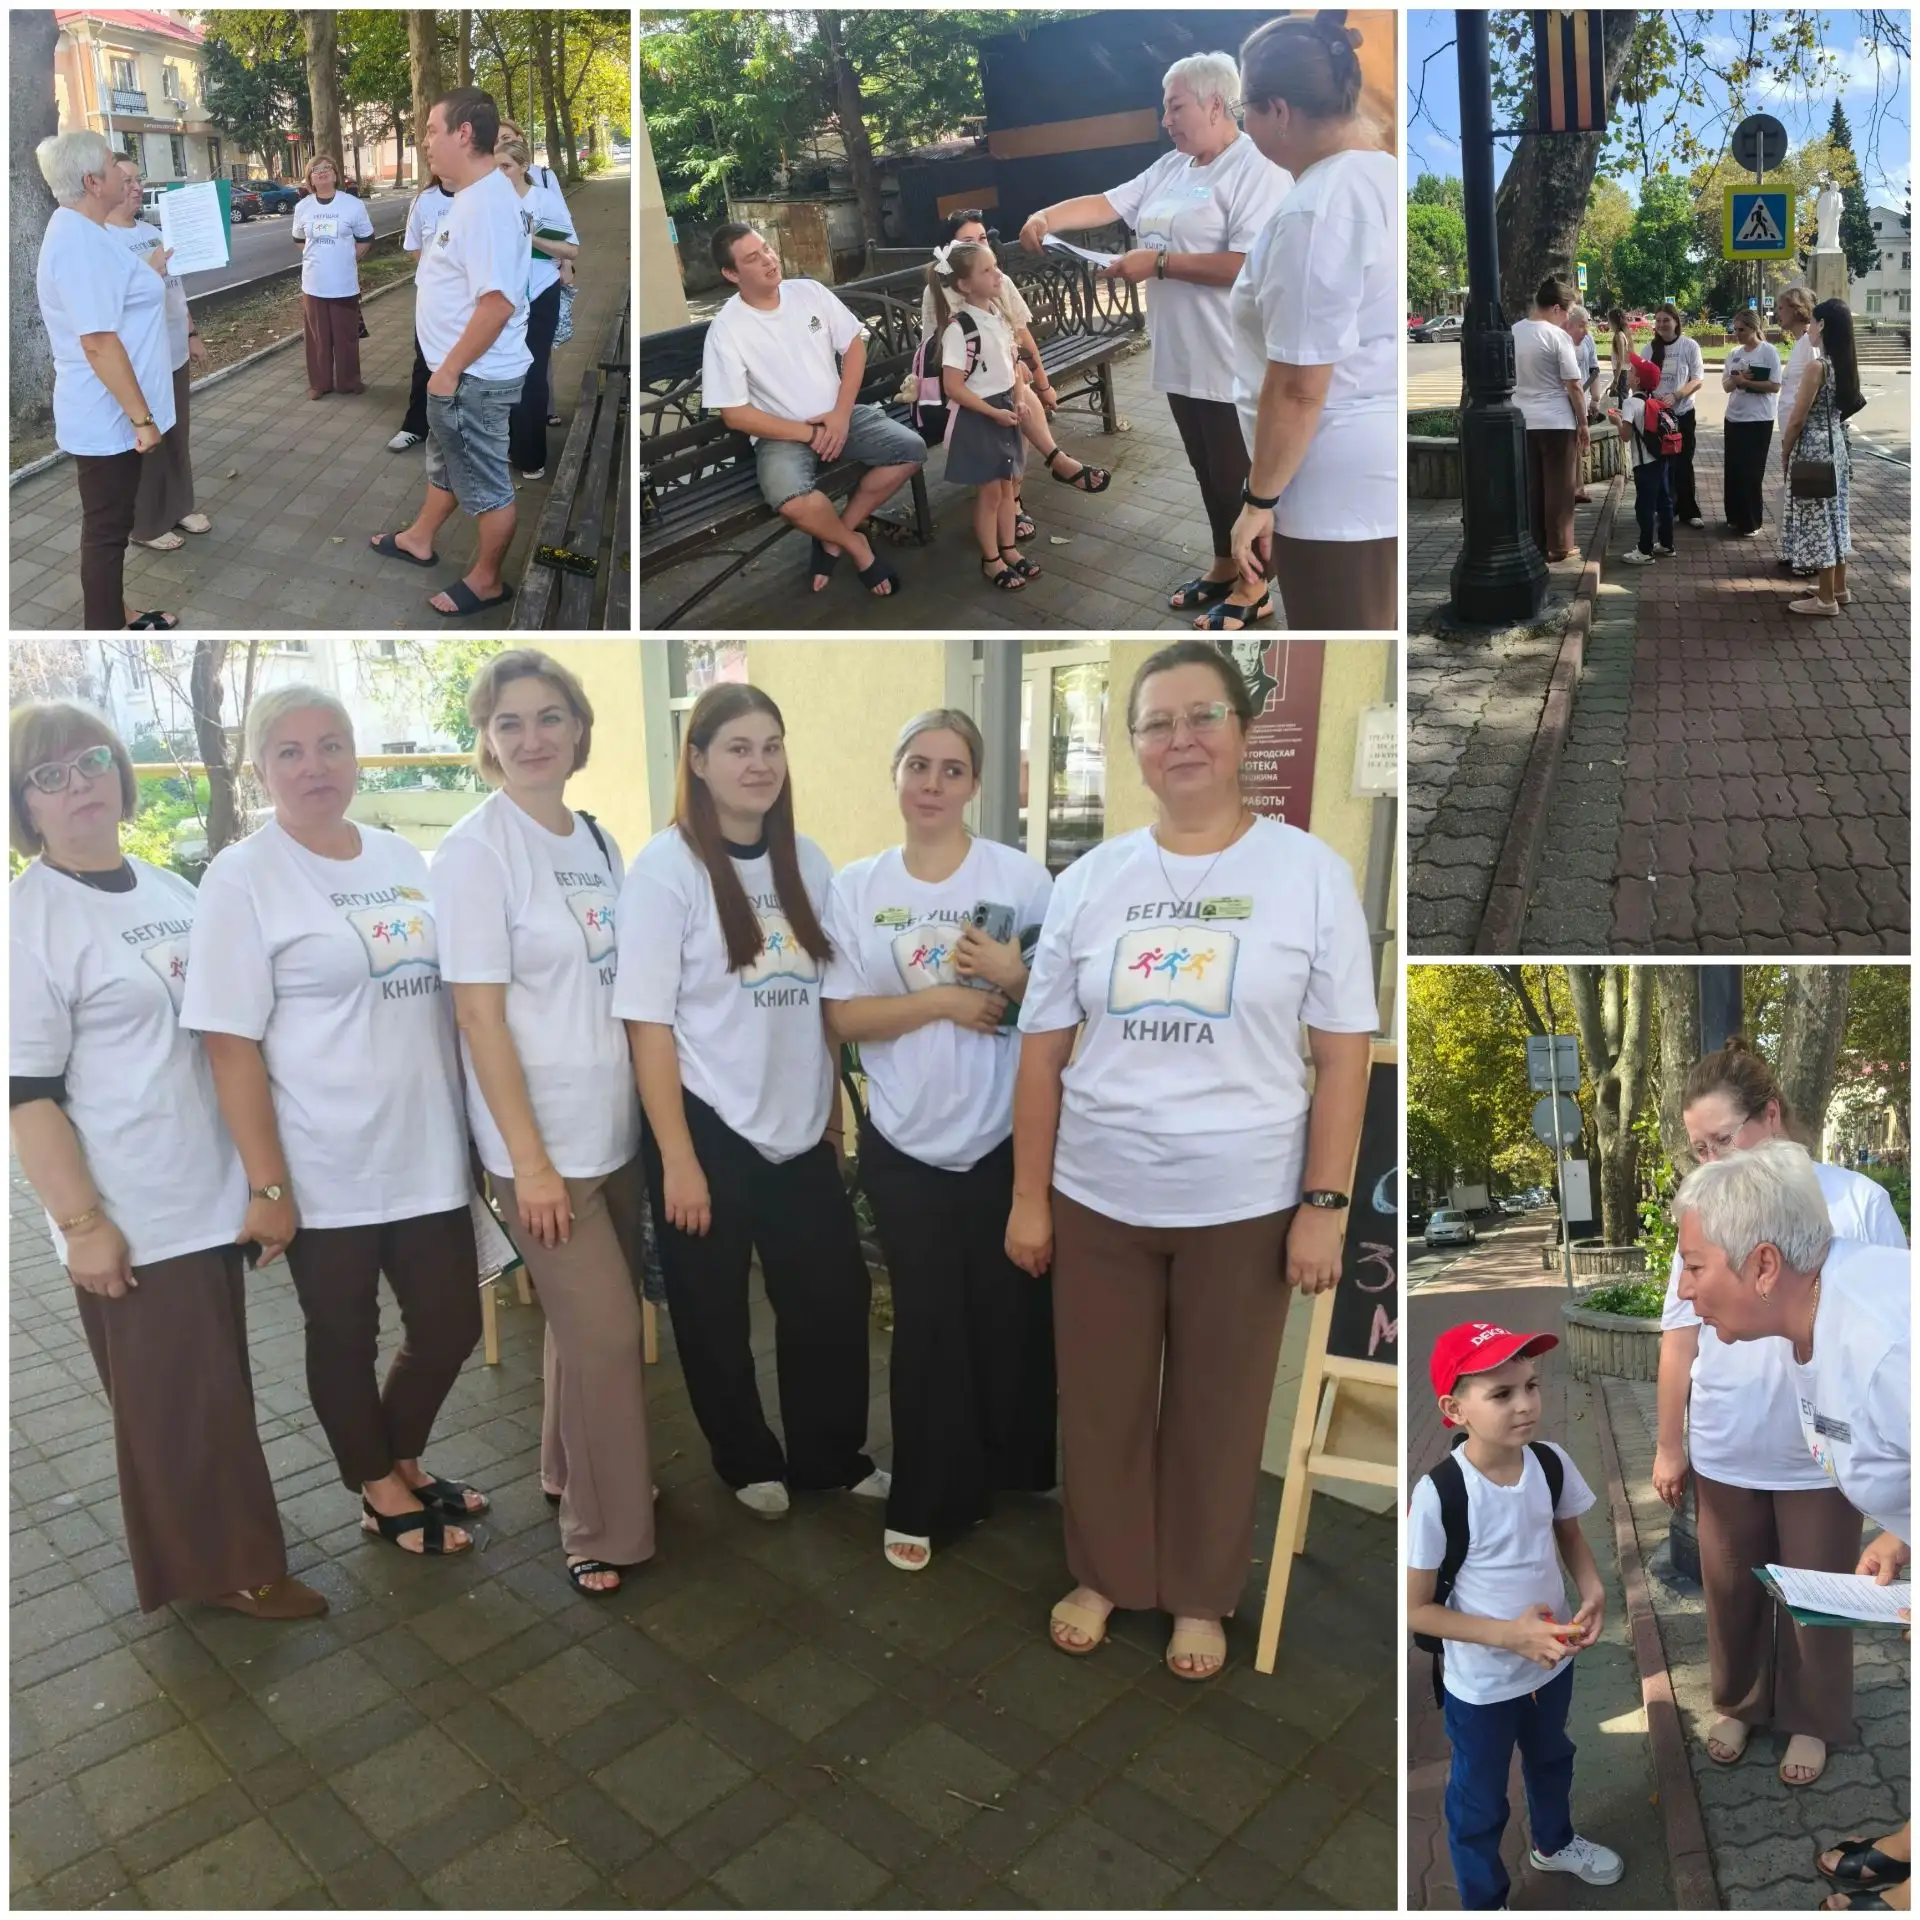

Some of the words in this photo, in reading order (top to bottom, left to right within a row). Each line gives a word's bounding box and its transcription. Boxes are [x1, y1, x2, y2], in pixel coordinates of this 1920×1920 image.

[1248, 748, 1296, 759] ГОРОДСКАЯ
[1241, 761, 1279, 772] ОТЕКА
[1242, 795, 1286, 807] РАБОТЫ
[554, 870, 609, 888] БЕГУЩА
[329, 886, 401, 907] БЕГУЩА
[1125, 901, 1202, 922] БЕГУЩ
[121, 918, 194, 946] БЕГУЩА
[381, 974, 443, 1000] КНИГА
[753, 988, 810, 1008] КНИГА
[1122, 1019, 1215, 1045] КНИГА
